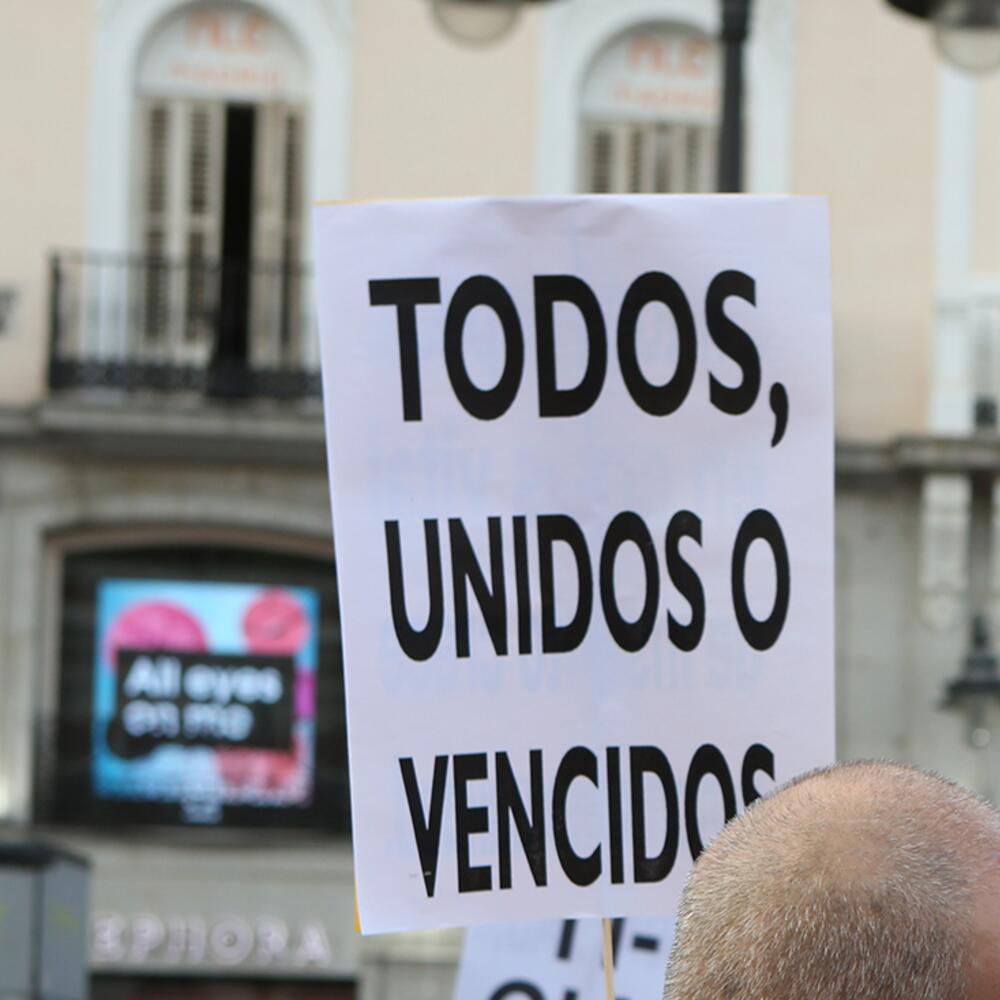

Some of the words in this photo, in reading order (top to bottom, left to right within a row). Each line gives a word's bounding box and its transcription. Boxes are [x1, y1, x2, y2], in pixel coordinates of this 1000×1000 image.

[368, 269, 789, 447] TODOS,
[384, 509, 706, 662] UNIDOS
[731, 508, 791, 652] O
[123, 700, 181, 737] on
[183, 702, 254, 741] me
[124, 656, 182, 699] All
[183, 665, 284, 707] eyes
